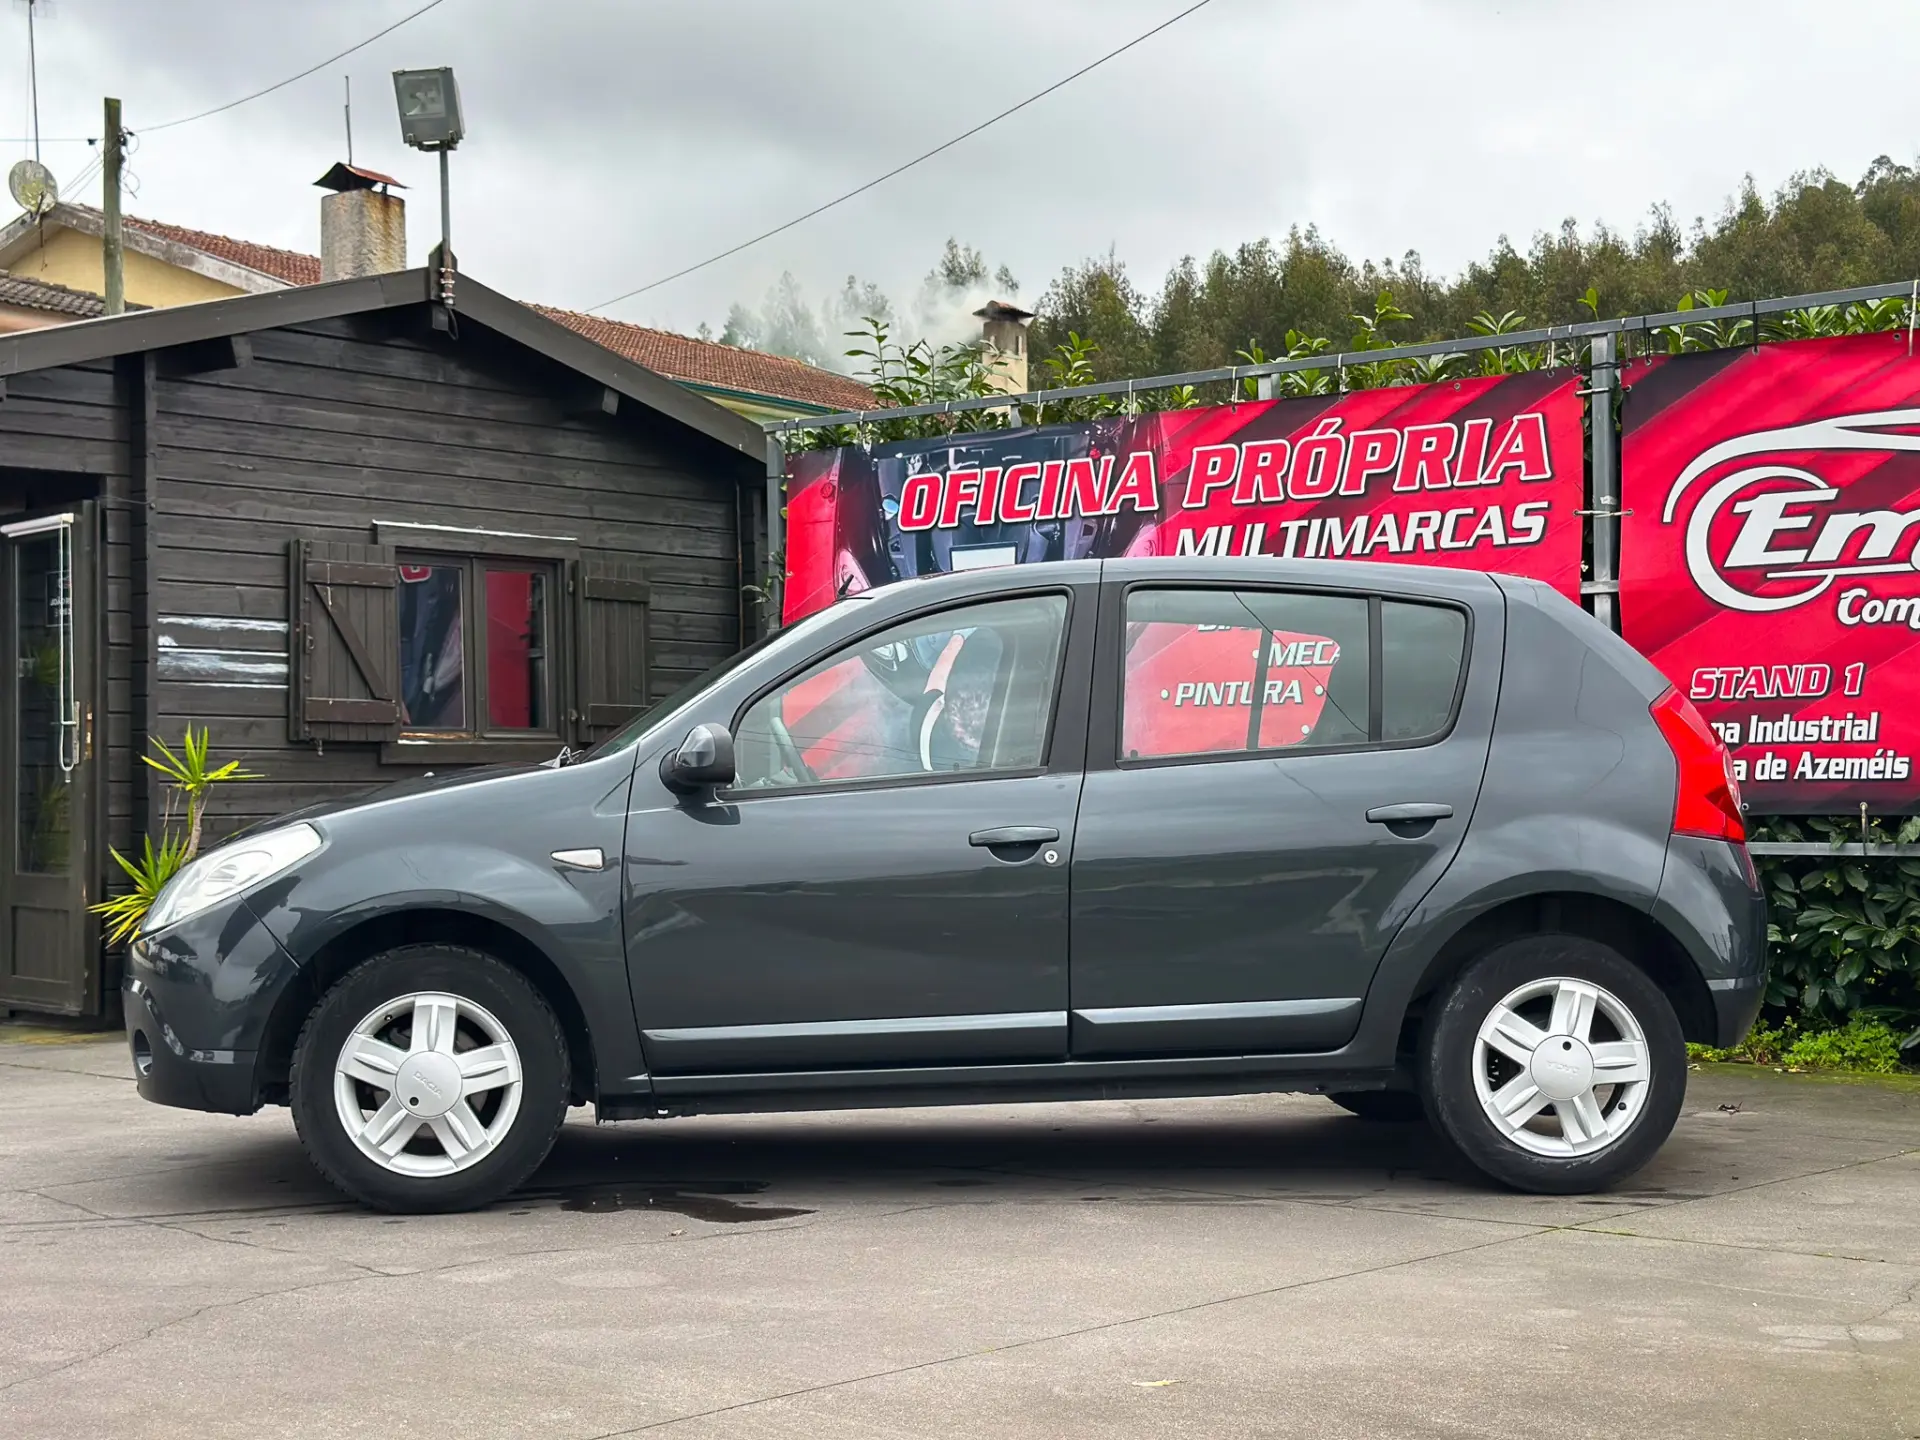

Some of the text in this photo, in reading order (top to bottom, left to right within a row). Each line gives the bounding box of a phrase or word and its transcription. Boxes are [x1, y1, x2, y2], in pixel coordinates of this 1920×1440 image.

[898, 413, 1552, 531] OFICINA PRÓPRIA
[1174, 501, 1550, 559] MULTIMARCAS
[1174, 680, 1303, 706] PINTURA
[1690, 662, 1864, 699] STAND 1
[1748, 711, 1879, 743] Industrial
[1755, 751, 1788, 780] de
[1793, 748, 1910, 780] Azeméis
